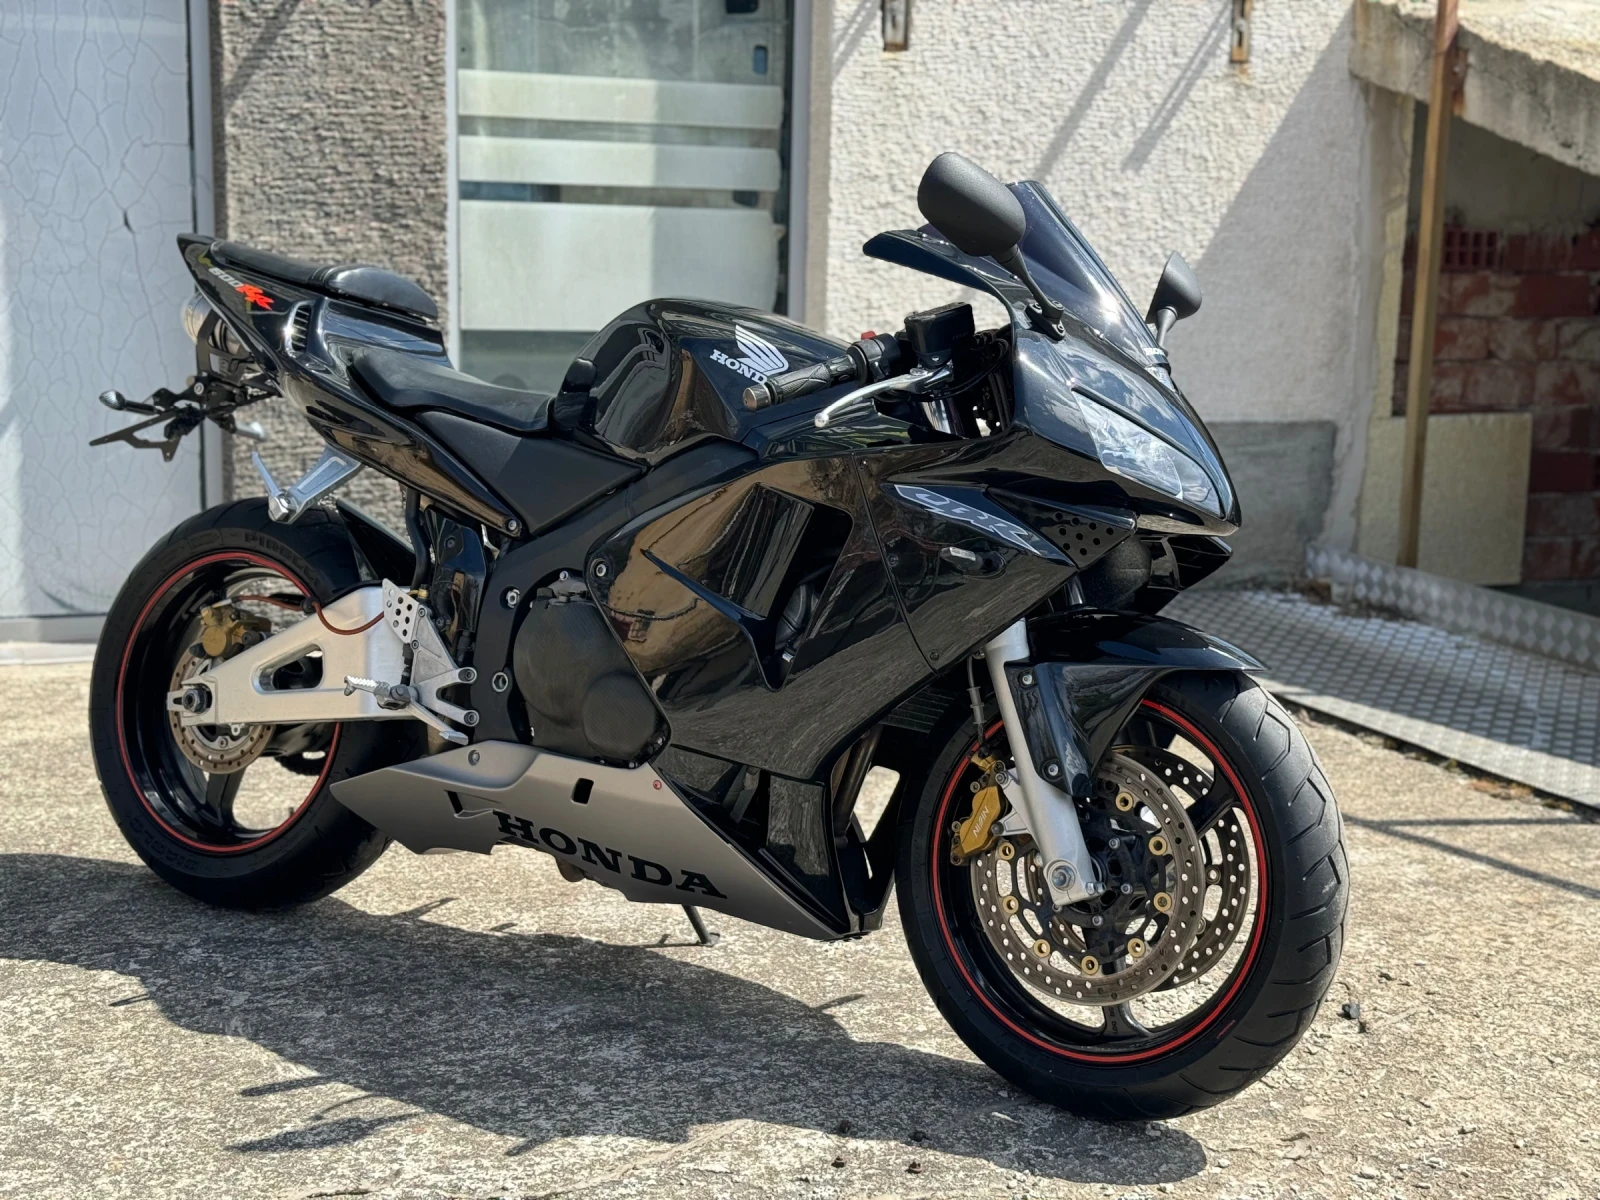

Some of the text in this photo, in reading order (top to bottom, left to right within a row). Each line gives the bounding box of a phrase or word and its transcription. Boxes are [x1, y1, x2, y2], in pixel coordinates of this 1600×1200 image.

[709, 349, 768, 385] HOND
[972, 805, 990, 838] NISSIN
[493, 809, 728, 899] HONDA
